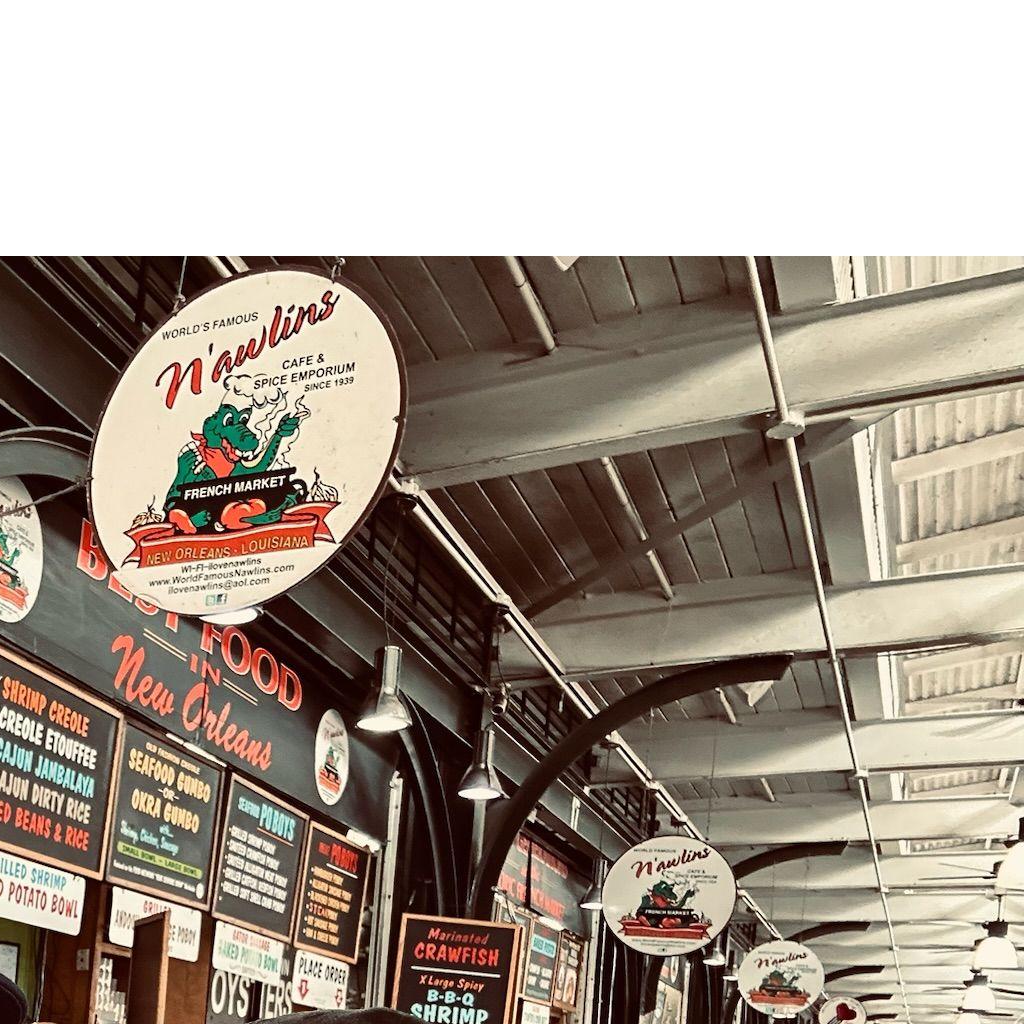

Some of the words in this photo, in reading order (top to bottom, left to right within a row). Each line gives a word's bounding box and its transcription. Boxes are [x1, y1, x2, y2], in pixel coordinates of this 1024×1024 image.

[162, 322, 210, 340] WORLD'S
[212, 312, 259, 329] FAMOUS
[282, 355, 314, 370] CAFE
[316, 353, 325, 363] &
[253, 373, 287, 390] SPICE
[290, 362, 356, 382] EMPORIUM
[304, 381, 331, 393] SINCE
[334, 376, 354, 388] 1939
[184, 483, 232, 500] FRENCH
[234, 475, 286, 493] MARKET
[146, 551, 172, 565] NEW
[176, 547, 230, 561] ORLEANS
[241, 536, 309, 555] LOUISIANA
[149, 564, 295, 587] www.WorldFamousNawlins.com
[168, 577, 270, 595] ilovenawlins@aol.com
[190, 653, 221, 686] IN
[200, 622, 302, 711] FOOD
[2, 676, 47, 716] SHRIMP
[49, 700, 90, 737] CREOLE
[111, 634, 175, 716] New
[182, 682, 272, 771] Orleans
[45, 728, 98, 770] ETOUFFEE
[35, 755, 95, 798] JAMBALAYA
[129, 748, 175, 787] SEAFOOD
[177, 771, 211, 803] GUMBO
[32, 783, 65, 815] DIRTY
[66, 797, 91, 825] RICE
[131, 788, 161, 819] OKRA
[163, 802, 200, 834] GUMBO
[15, 807, 51, 839] BEANS
[53, 823, 62, 843] &
[65, 824, 90, 851] RICE
[30, 867, 67, 891] SHRIMP
[8, 882, 47, 911] POTATO
[51, 894, 78, 918] BOWL
[427, 927, 490, 945] Marinated
[263, 954, 278, 973] BOWL
[413, 942, 500, 967] CRAWFISH
[298, 957, 322, 980] PLACE
[324, 965, 346, 985] ORDER
[419, 974, 427, 985] X
[428, 975, 455, 990] Large
[456, 978, 485, 993] Spicy
[427, 989, 475, 1007] B-B-Q
